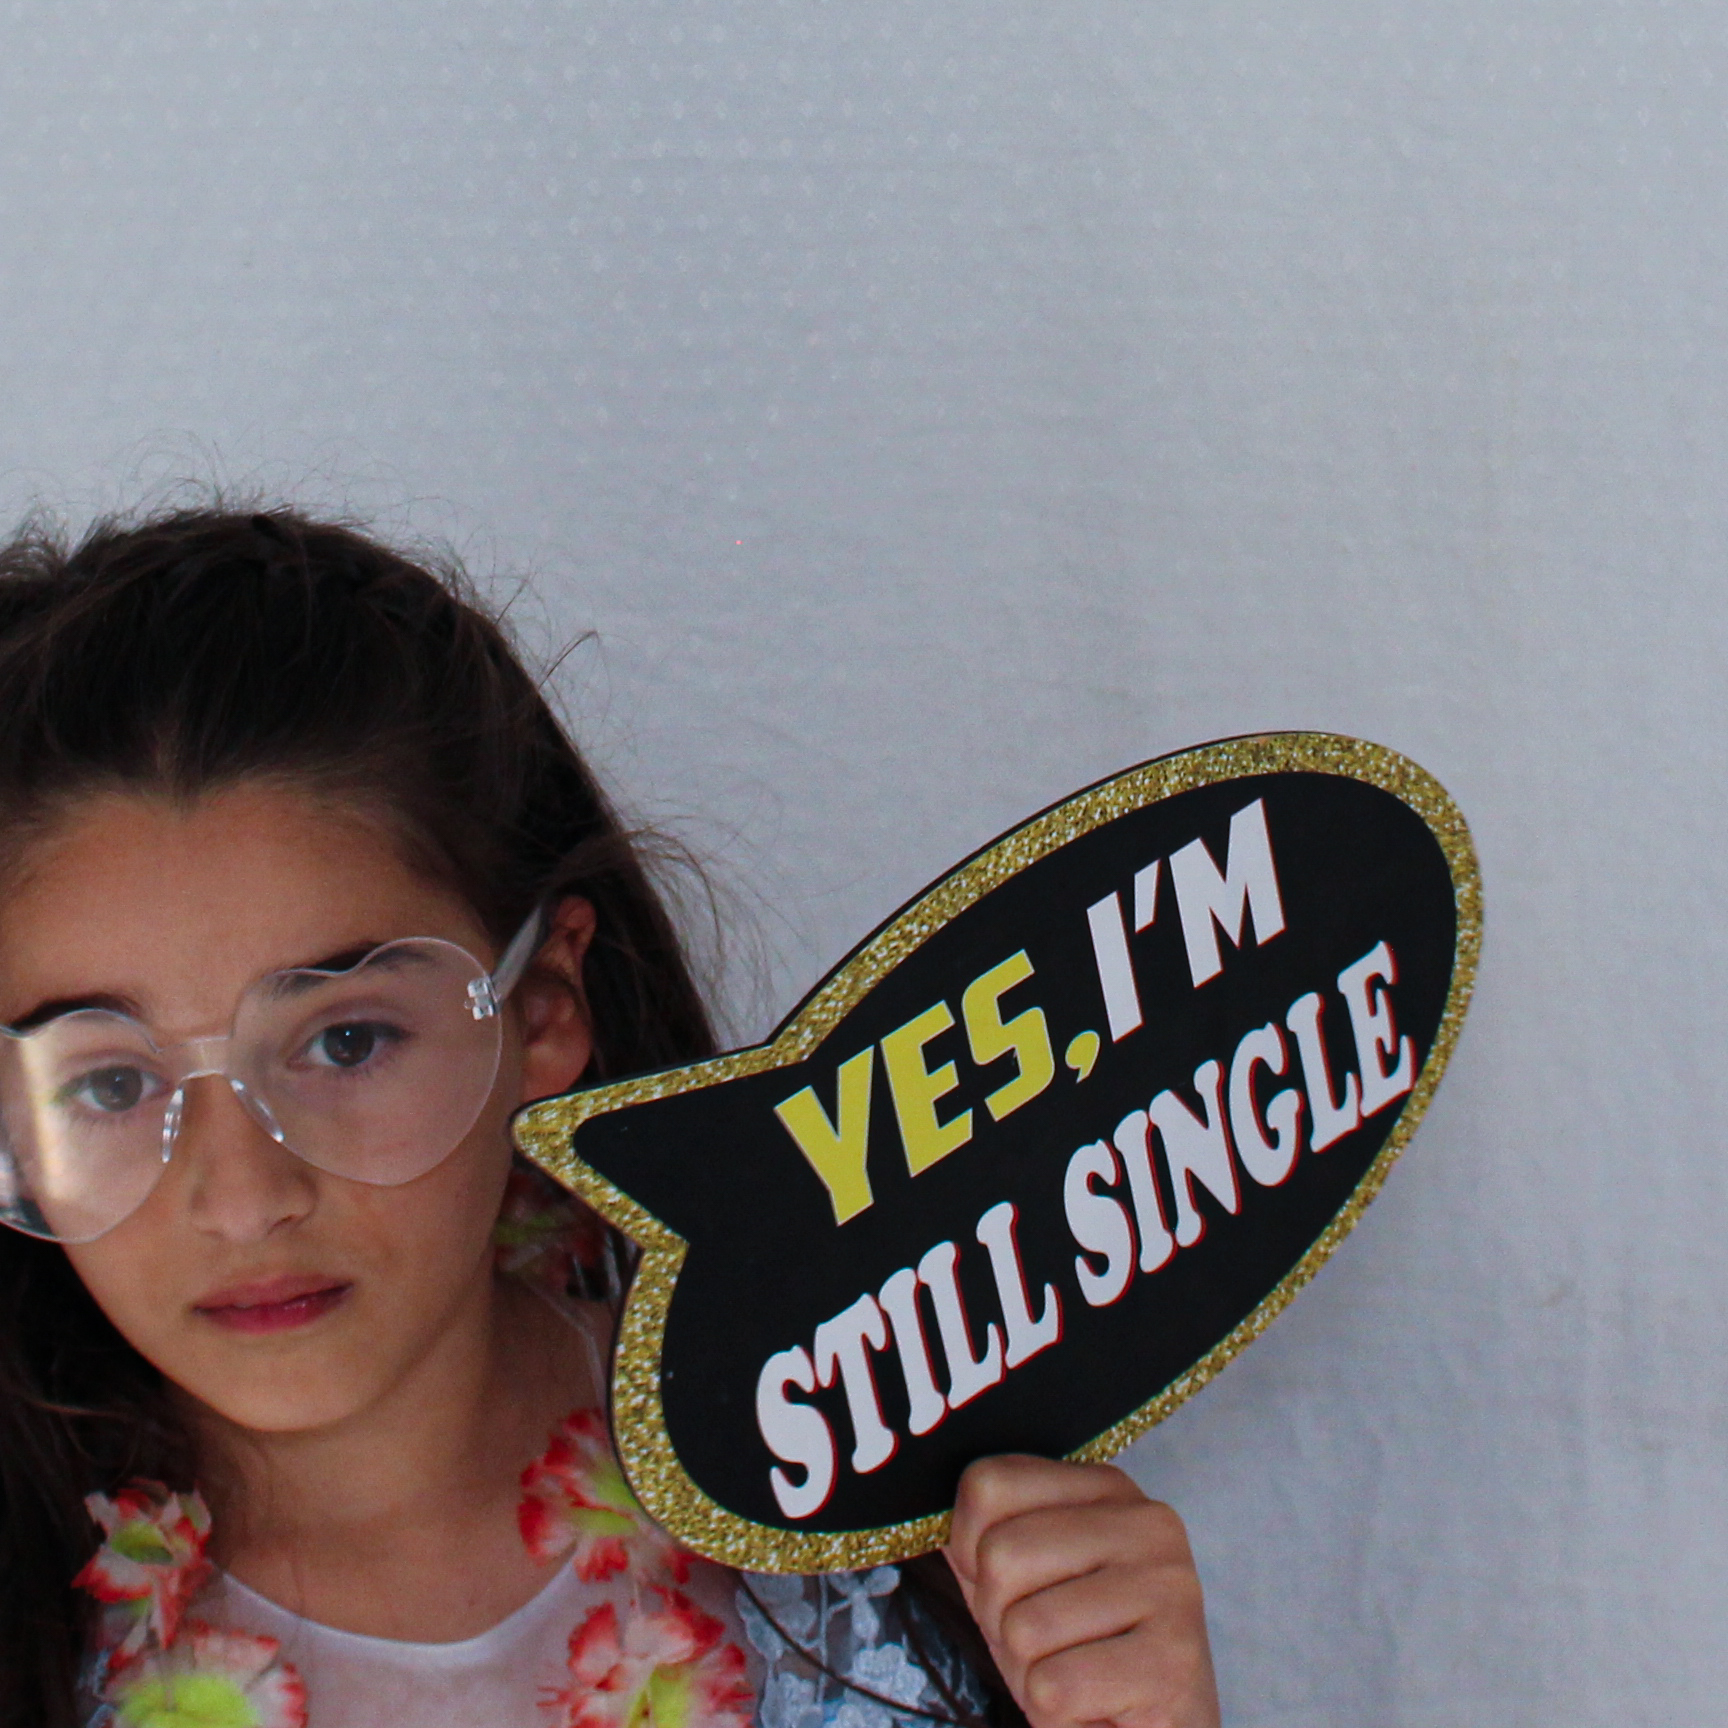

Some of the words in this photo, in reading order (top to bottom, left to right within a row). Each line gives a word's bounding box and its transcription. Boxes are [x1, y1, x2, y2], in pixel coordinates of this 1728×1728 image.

[756, 1200, 1063, 1520] STILL
[1063, 939, 1416, 1308] SINGLE
[773, 948, 1101, 1227] YES,
[1086, 797, 1286, 1044] I'M
